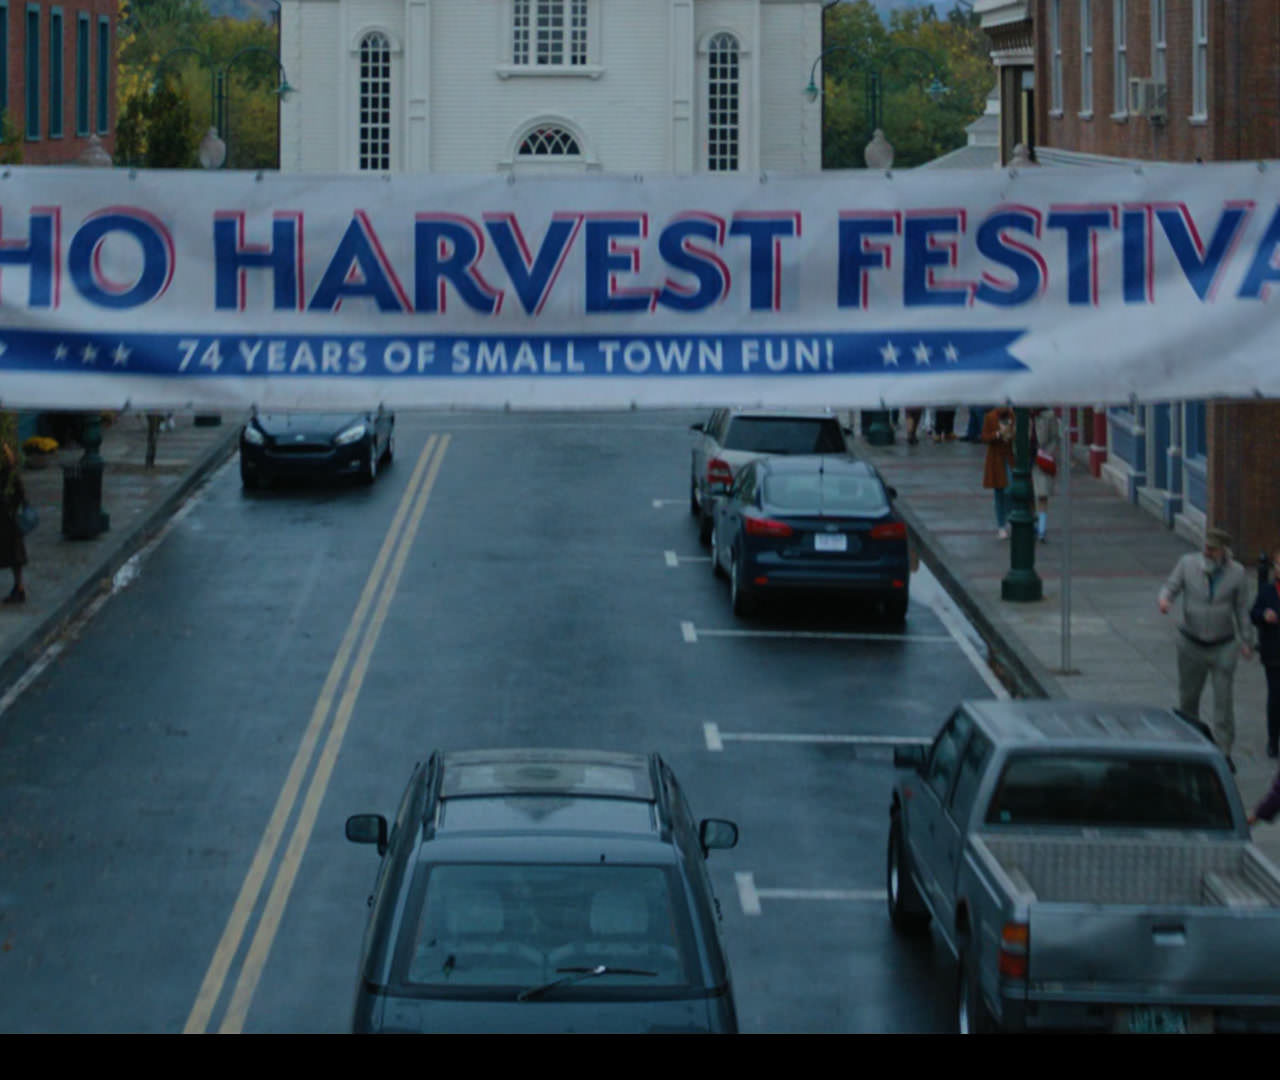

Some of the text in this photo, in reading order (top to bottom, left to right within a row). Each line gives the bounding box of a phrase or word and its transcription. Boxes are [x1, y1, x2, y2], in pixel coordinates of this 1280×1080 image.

[212, 206, 801, 316] HARVEST
[177, 336, 836, 374] 74 YEARS OF SMALL TOWN FUN!
